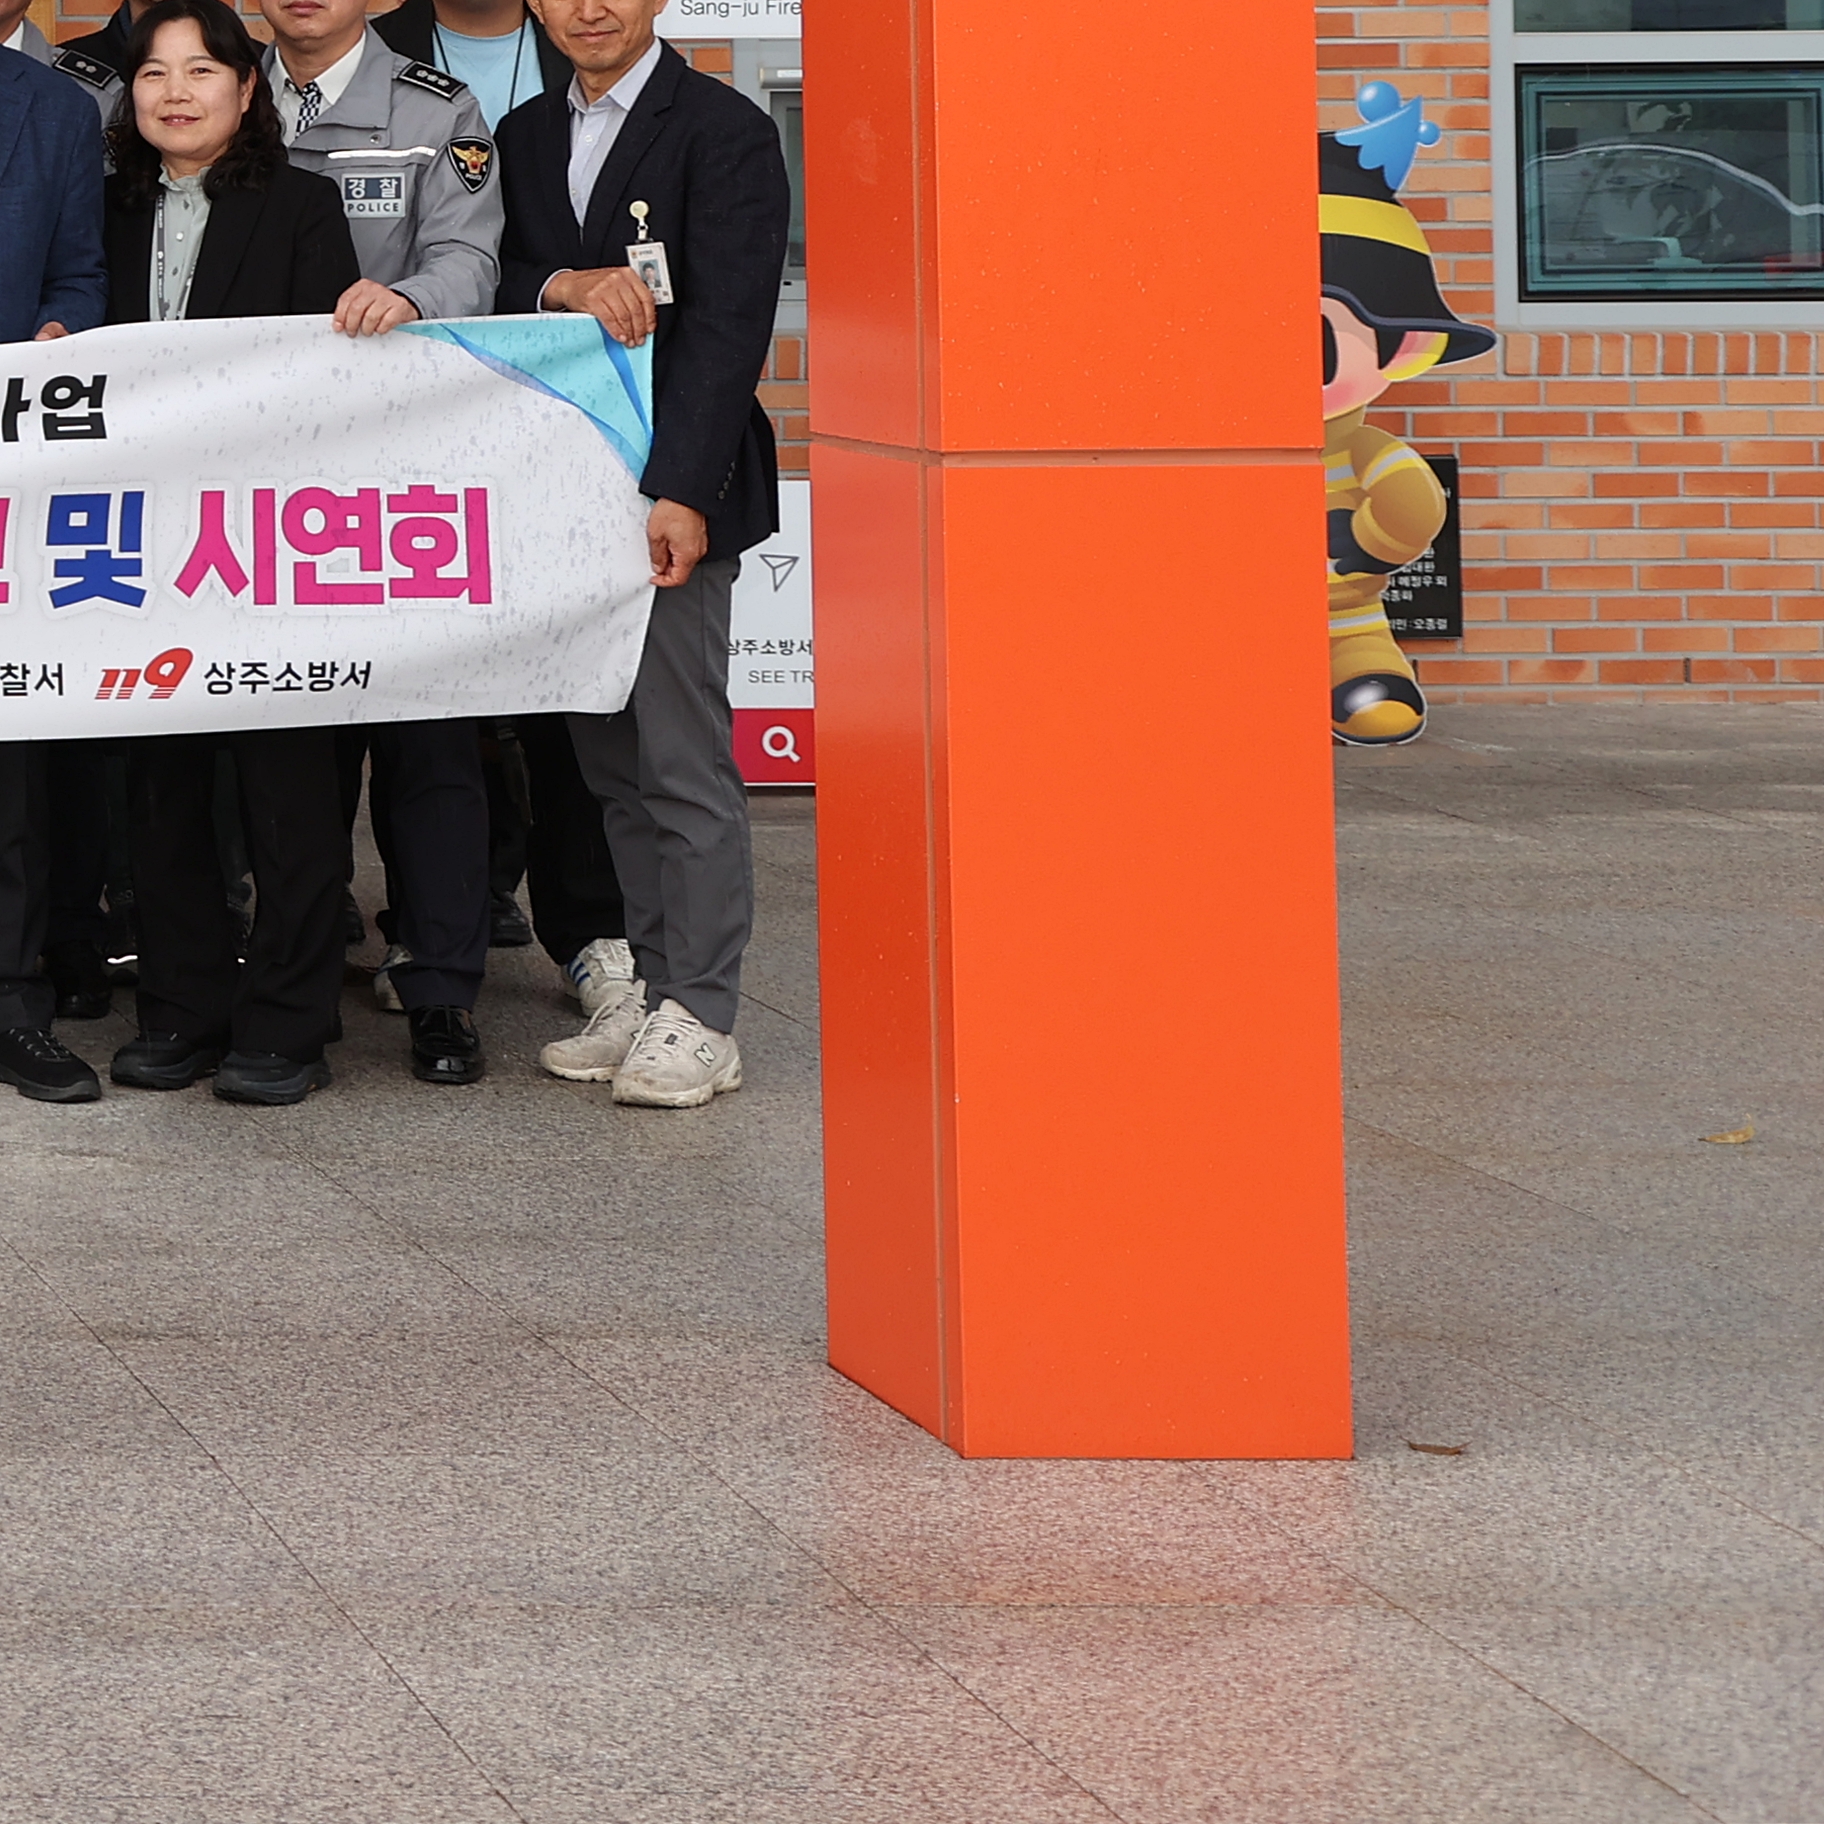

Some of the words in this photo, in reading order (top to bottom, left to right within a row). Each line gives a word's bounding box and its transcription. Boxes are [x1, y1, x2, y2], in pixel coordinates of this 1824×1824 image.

[347, 203, 399, 213] POLICE
[45, 491, 147, 609] 및
[173, 484, 492, 606] 시연회
[94, 647, 194, 700] 119
[204, 660, 372, 695] 상주소방서
[748, 670, 785, 683] SEE
